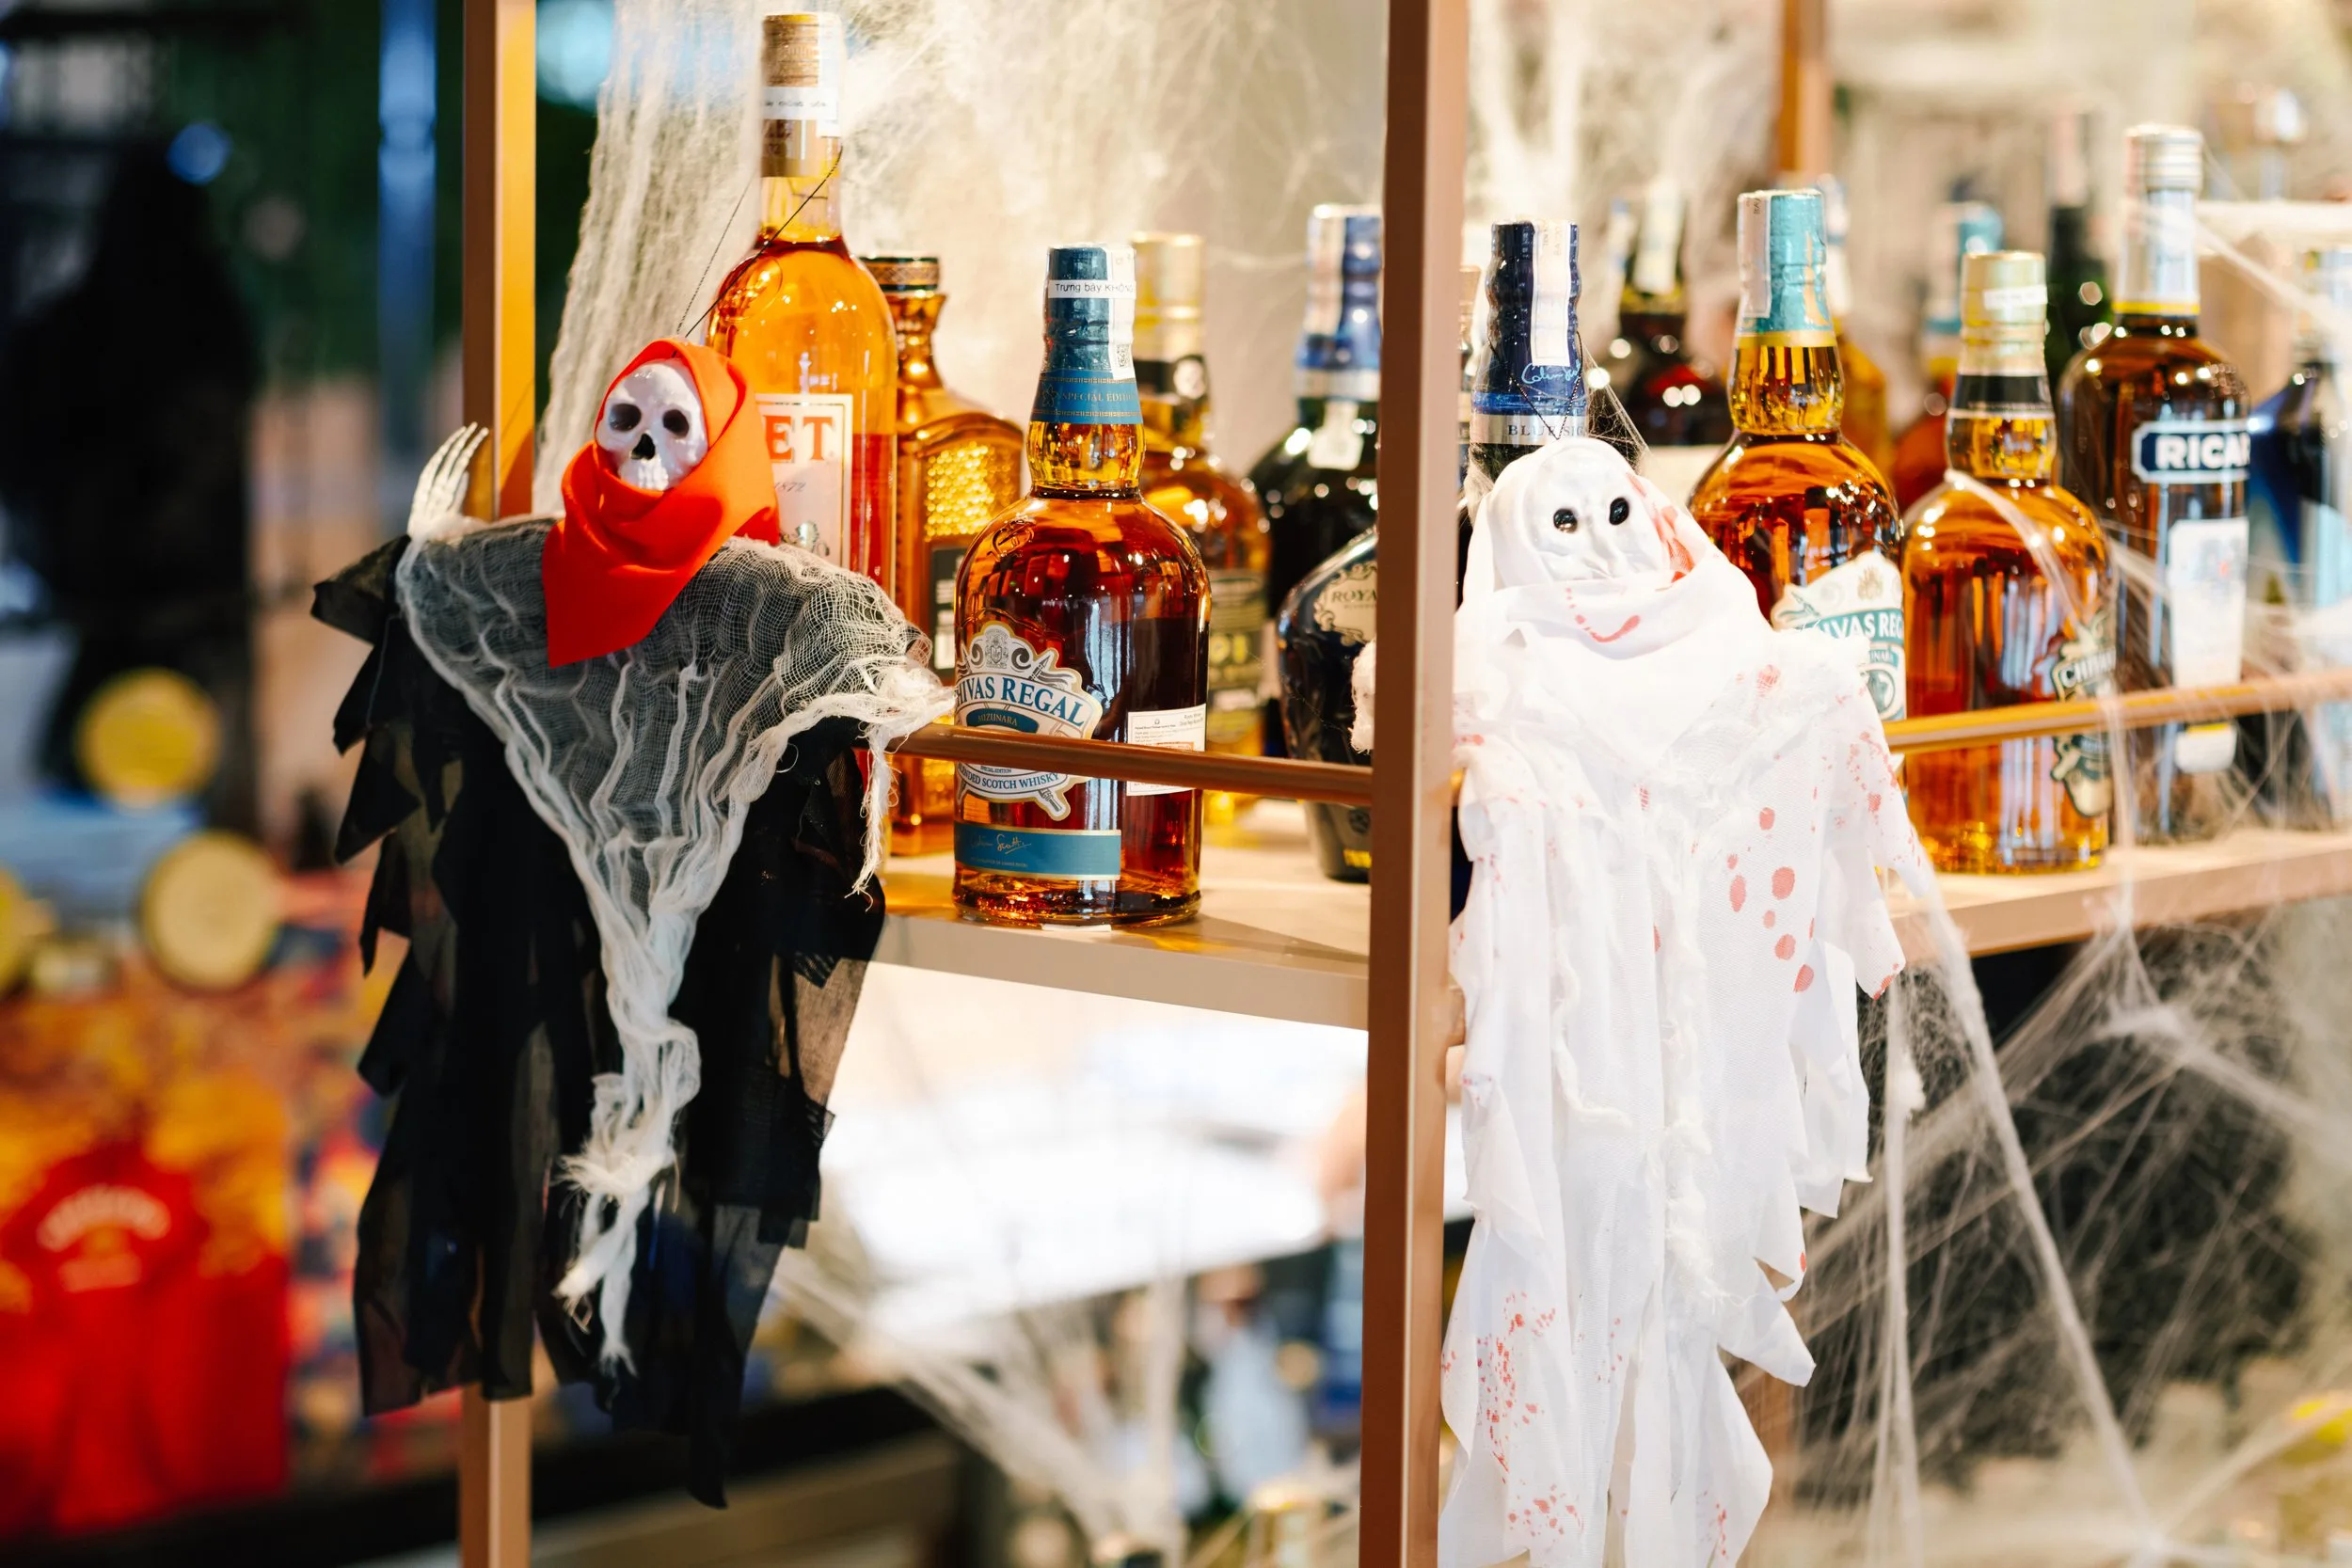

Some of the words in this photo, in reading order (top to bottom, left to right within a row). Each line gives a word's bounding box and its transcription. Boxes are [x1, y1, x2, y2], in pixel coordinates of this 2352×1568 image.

[1508, 424, 1556, 436] BLUE
[774, 481, 807, 493] 1872
[1331, 589, 1378, 603] ROYA
[955, 676, 996, 705] HIVAS
[1001, 676, 1085, 727] REGAL
[981, 777, 1017, 789] SCOTCH
[1018, 771, 1059, 788] WHISKY
